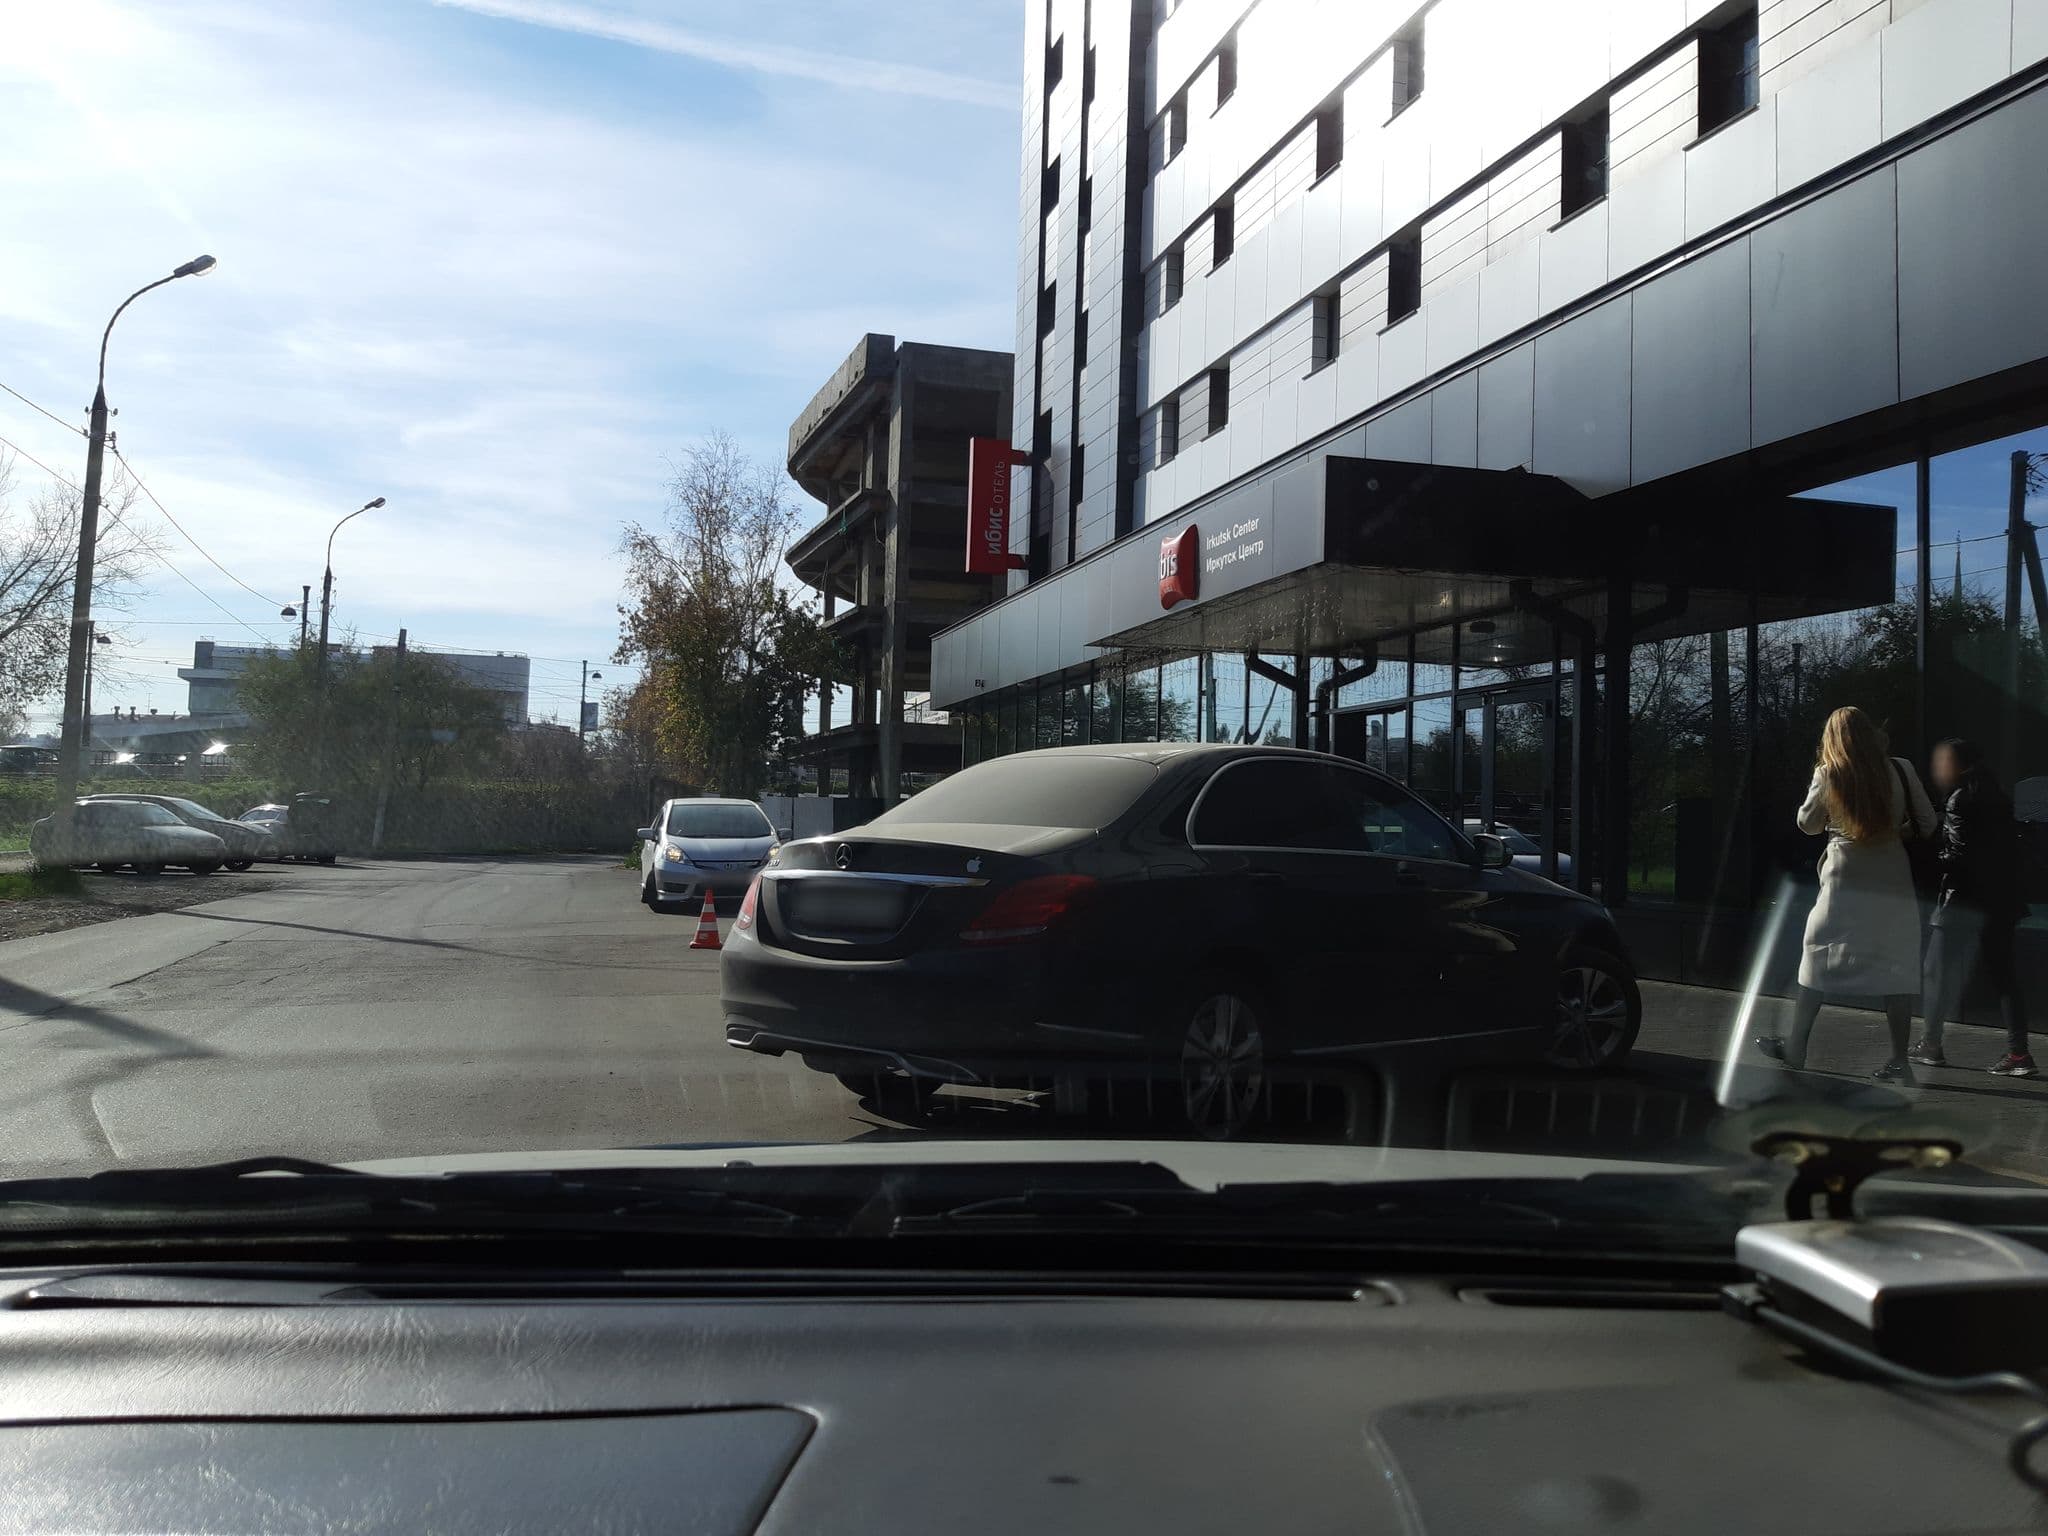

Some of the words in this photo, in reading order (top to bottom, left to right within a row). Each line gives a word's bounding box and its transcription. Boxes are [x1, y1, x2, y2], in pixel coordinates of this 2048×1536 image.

[993, 461, 1006, 504] ОТЕЛЬ
[985, 507, 1003, 555] ибис
[1206, 528, 1231, 550] Irkutsk
[1232, 518, 1260, 539] Center
[1206, 551, 1237, 573] Иркутск
[1238, 540, 1264, 561] Центр
